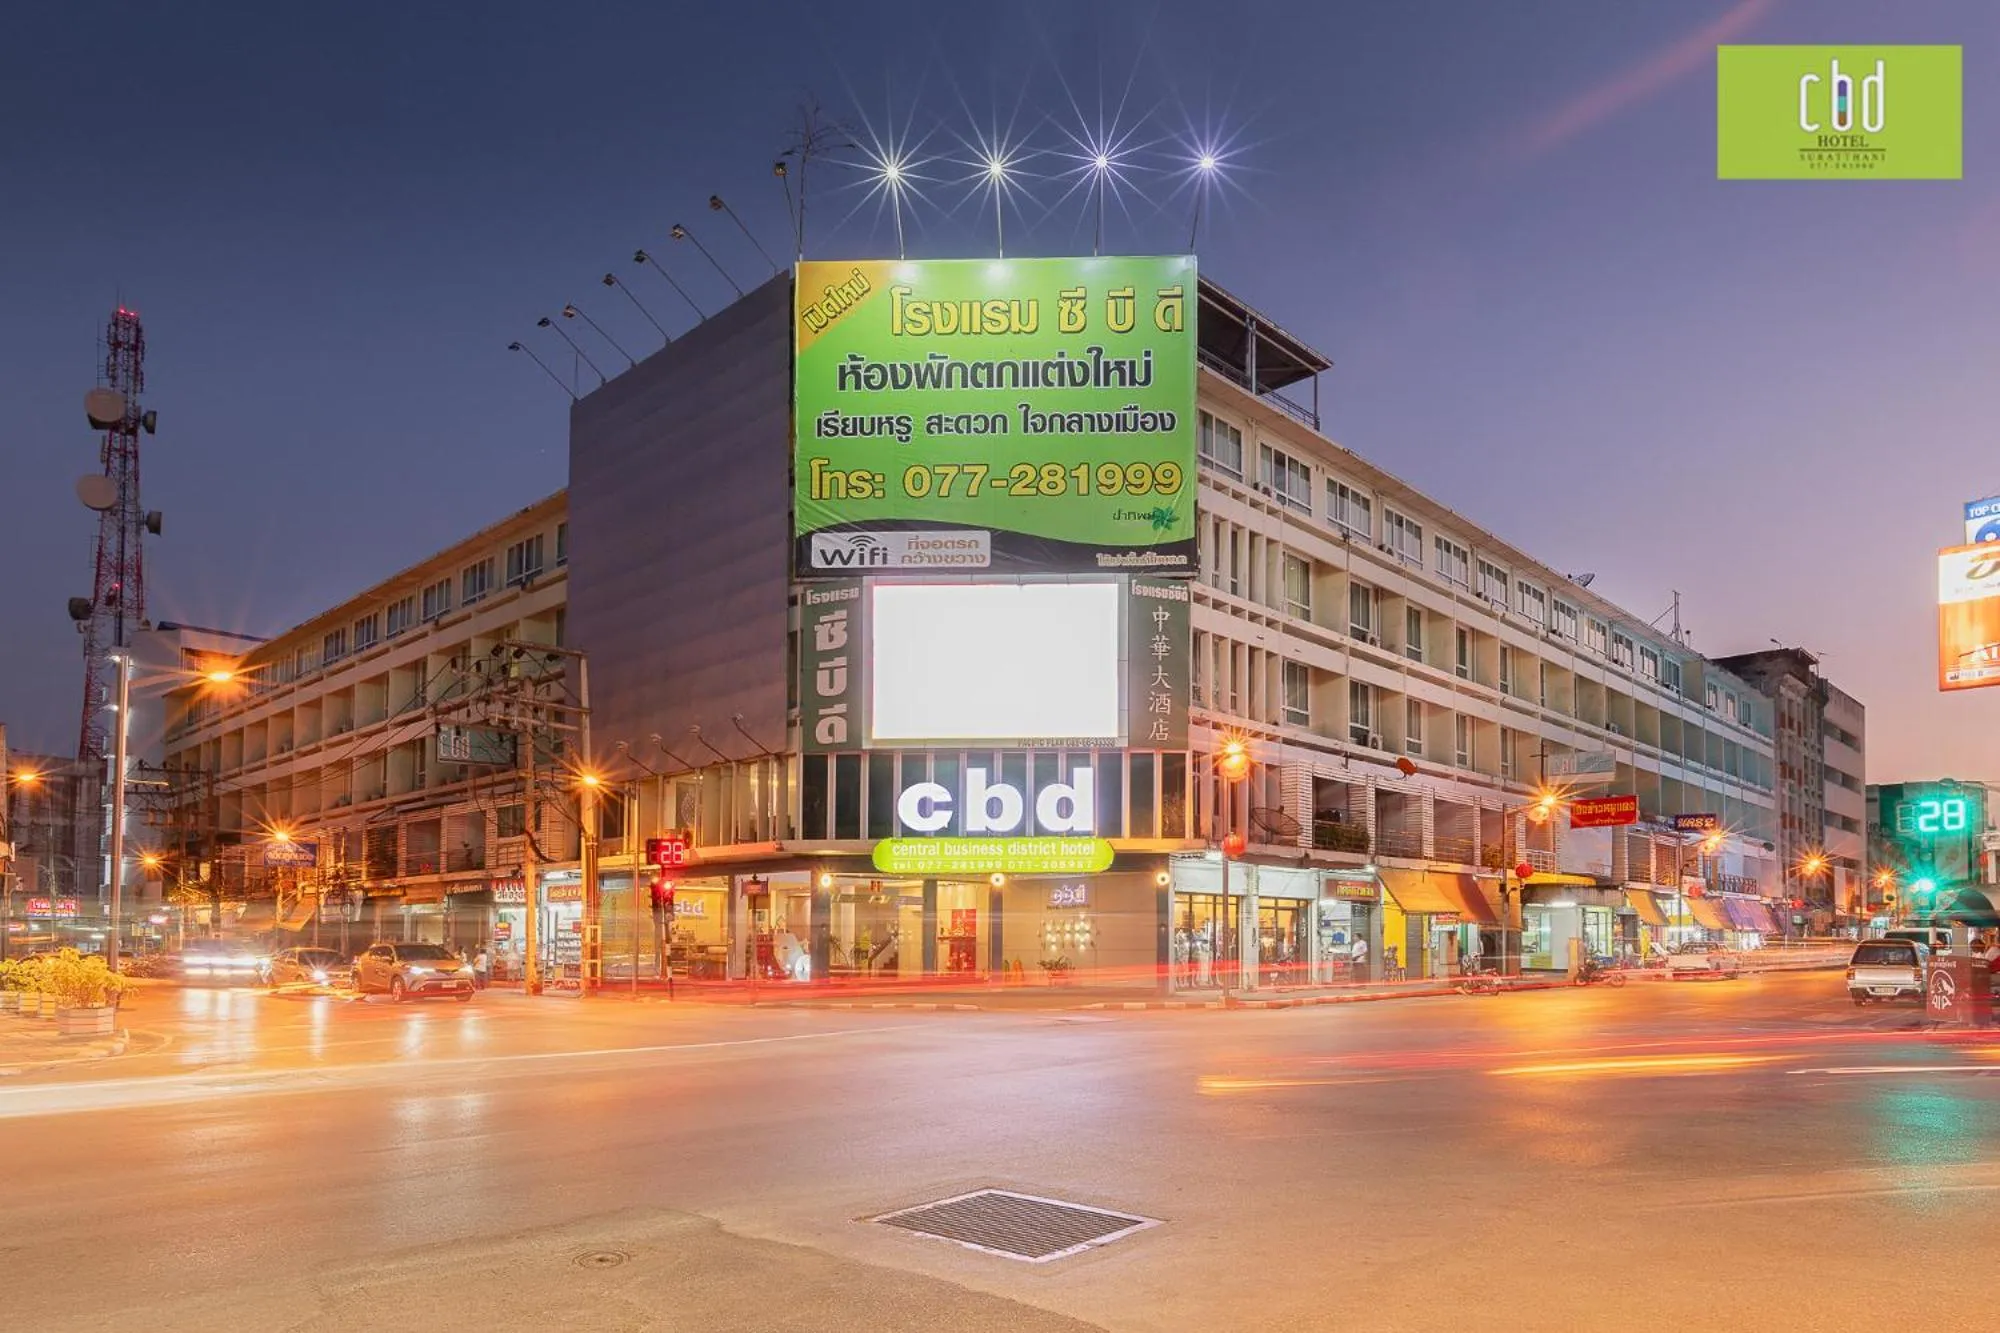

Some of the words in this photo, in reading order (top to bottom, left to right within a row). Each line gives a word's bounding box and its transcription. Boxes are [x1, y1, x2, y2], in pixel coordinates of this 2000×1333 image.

[801, 267, 871, 334] เปิดใหม่
[890, 286, 1040, 336] โรงแรม
[1057, 287, 1087, 333] ซี
[1106, 287, 1136, 333] บี
[1154, 285, 1184, 333] ดี
[837, 347, 1153, 392] ห้องพักตกแต่งใหม่
[816, 411, 913, 444] เรียบหรู
[926, 412, 1008, 436] สะดวก
[1018, 404, 1177, 434] ใจกลางเมือง
[809, 458, 885, 500] โทร:
[903, 463, 1183, 499] 077-281999
[806, 587, 859, 606] โรงแรม
[1148, 605, 1173, 742] 中華大酒店
[897, 767, 1095, 832] cbd
[1919, 799, 1966, 832] 28
[660, 842, 684, 864] 28
[892, 842, 940, 857] central
[944, 842, 1003, 857] business
[1008, 841, 1057, 856] district
[1061, 840, 1095, 856] hotel
[1932, 995, 1952, 1010] AIA
